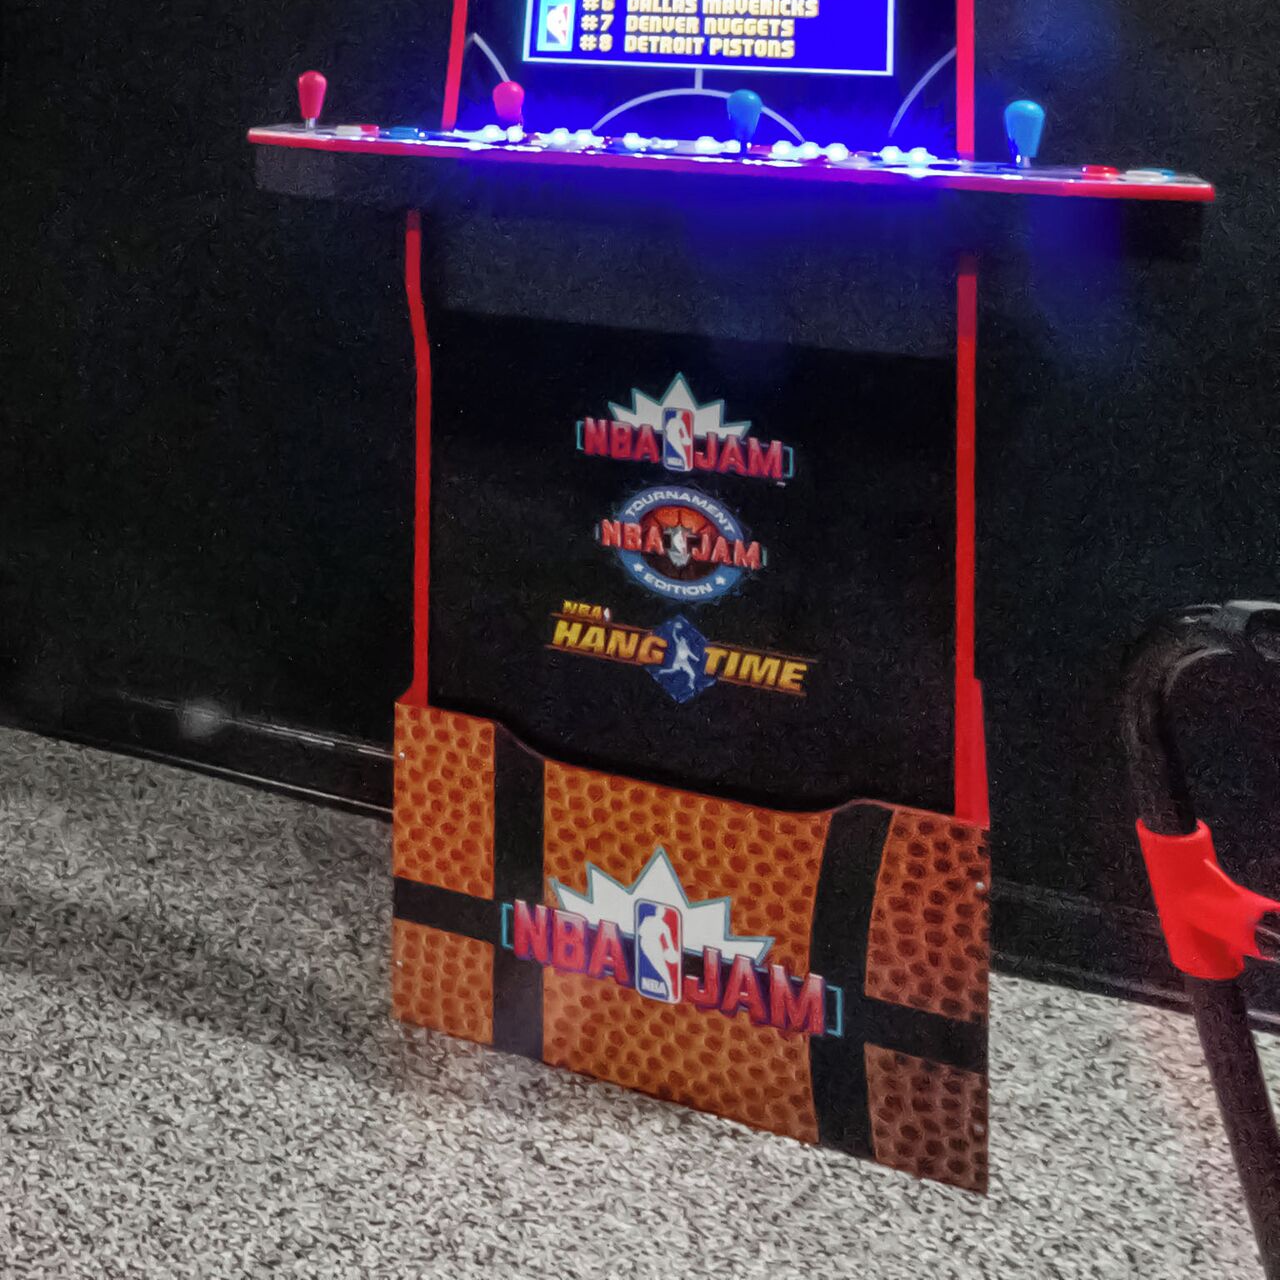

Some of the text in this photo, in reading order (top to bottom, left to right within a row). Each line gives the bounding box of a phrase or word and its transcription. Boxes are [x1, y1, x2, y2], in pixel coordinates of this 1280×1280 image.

[624, 35, 705, 55] DETROIT
[709, 37, 795, 58] PISTONS
[625, 15, 699, 34] DENVER
[703, 17, 794, 37] NUGGETS
[583, 417, 783, 479] NBA JAM
[624, 490, 736, 534] TOURNAMENT
[601, 519, 761, 570] NBA JAM
[643, 572, 714, 596] EDITION
[562, 599, 603, 620] NBA
[552, 619, 808, 691] HANG TIME
[513, 898, 826, 1035] NBA JAM
